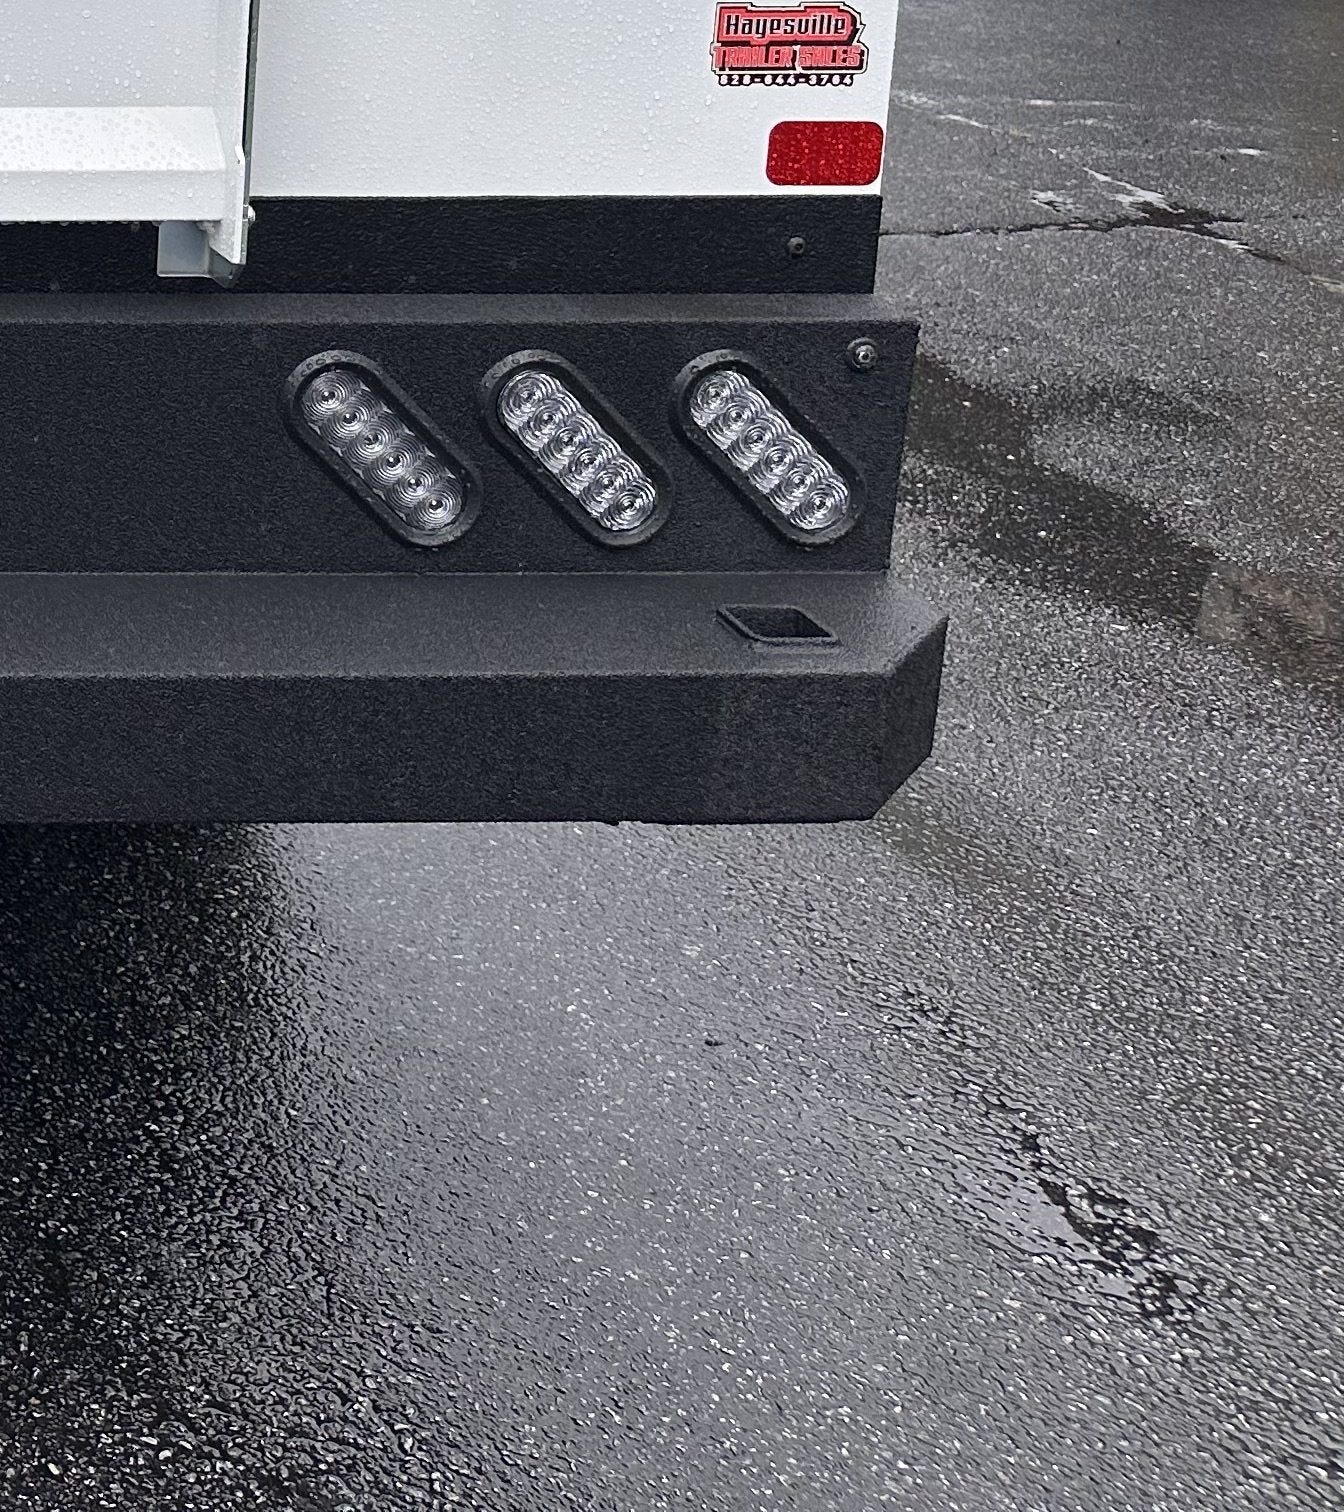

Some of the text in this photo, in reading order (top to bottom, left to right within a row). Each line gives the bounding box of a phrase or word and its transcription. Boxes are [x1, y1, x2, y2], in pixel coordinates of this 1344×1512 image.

[725, 14, 846, 38] Hayesville
[714, 45, 862, 68] TRAILER SALES
